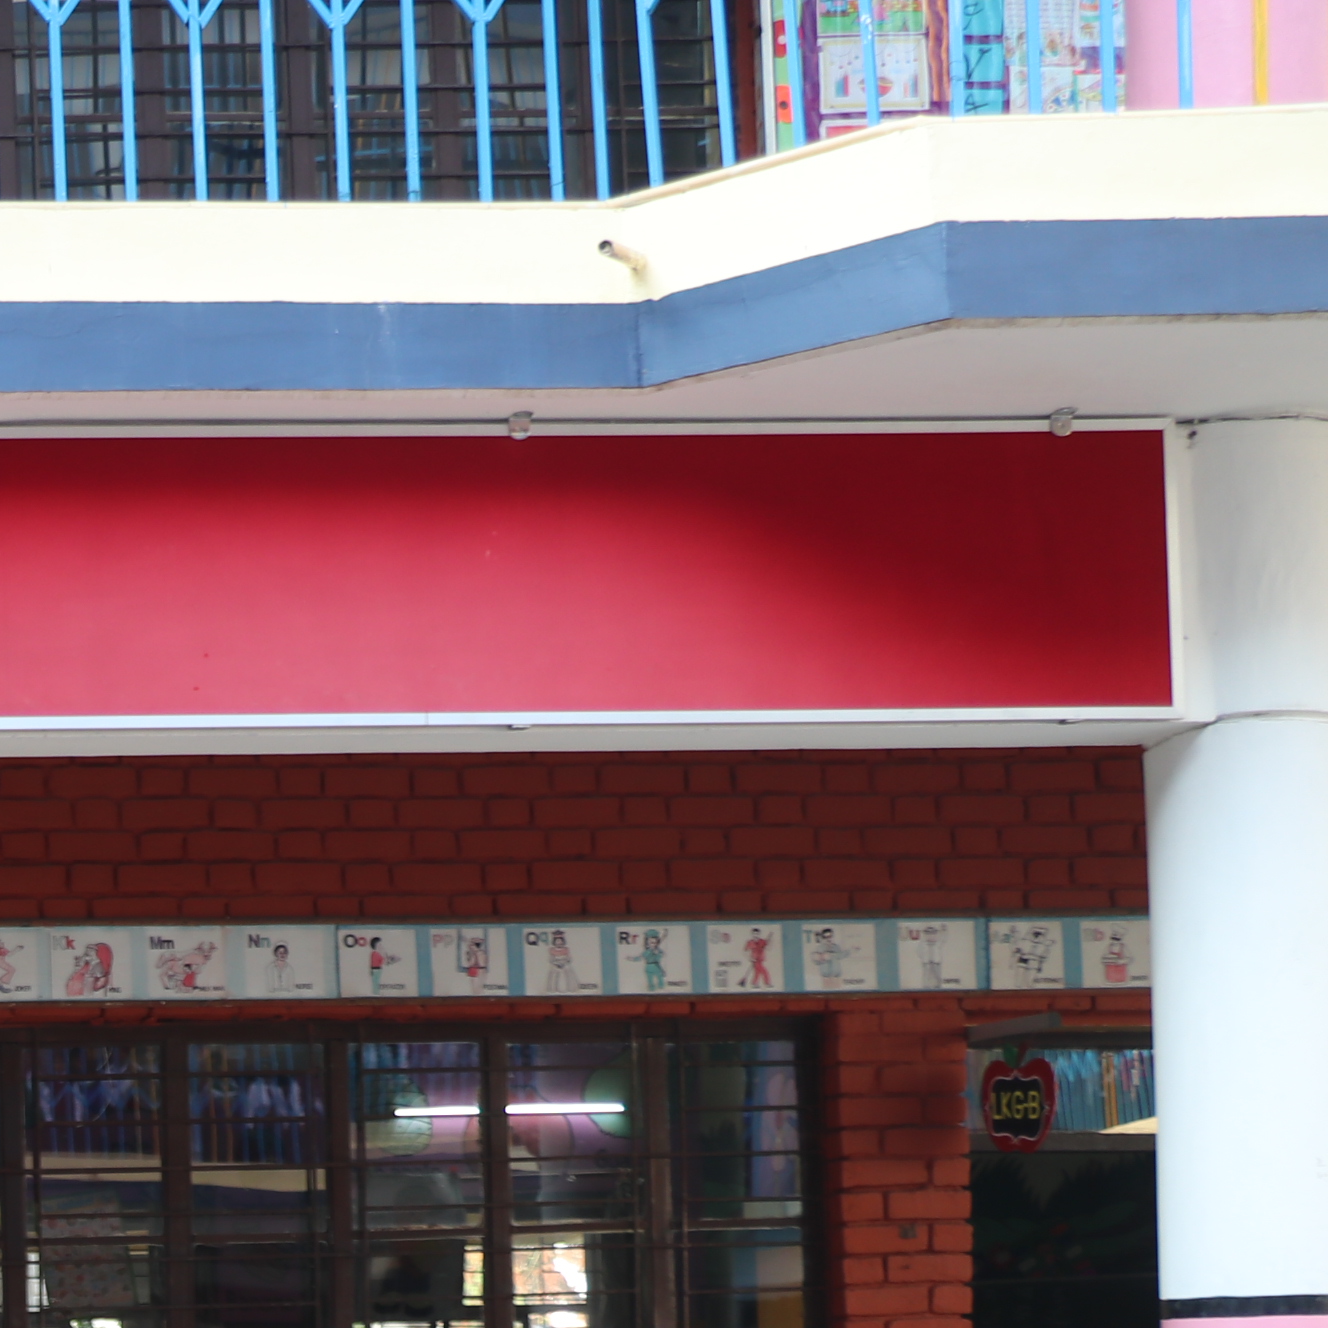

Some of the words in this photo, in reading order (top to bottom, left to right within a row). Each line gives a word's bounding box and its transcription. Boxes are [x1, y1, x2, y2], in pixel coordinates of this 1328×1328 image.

[52, 936, 76, 950] Kk
[150, 936, 175, 950] Mm
[248, 934, 271, 948] Nn
[343, 934, 368, 948] Oo
[618, 931, 639, 945] Rr
[991, 1090, 1042, 1120] LKG-B
